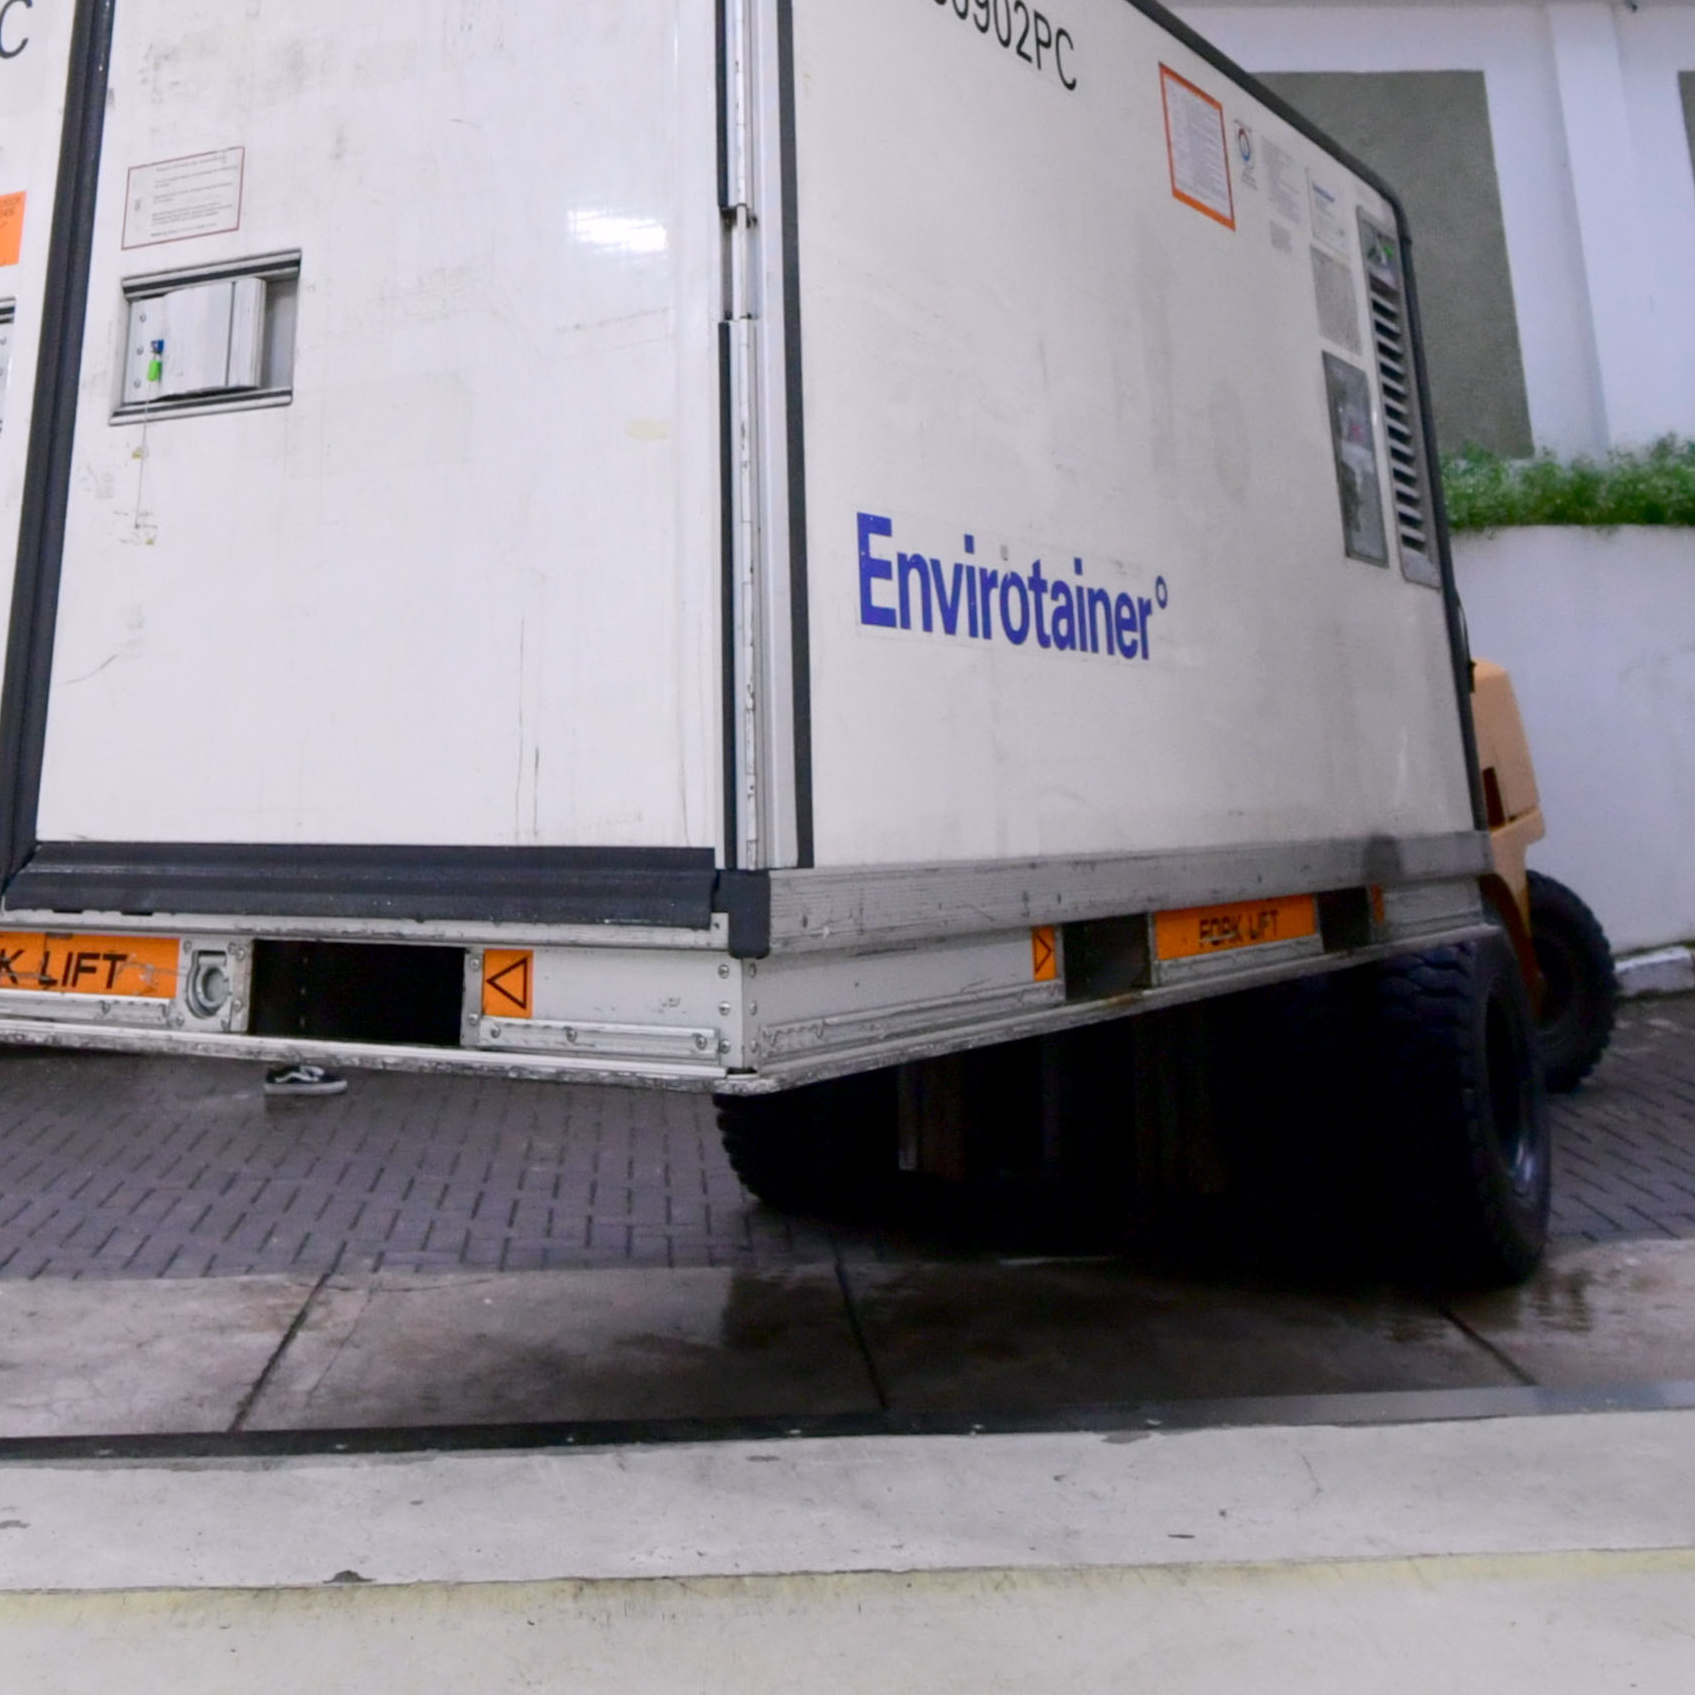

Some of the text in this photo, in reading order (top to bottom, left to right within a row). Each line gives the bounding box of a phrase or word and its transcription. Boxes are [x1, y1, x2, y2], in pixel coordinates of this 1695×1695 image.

[1199, 909, 1279, 949] FORK LIFT
[38, 951, 128, 990] LIFT
